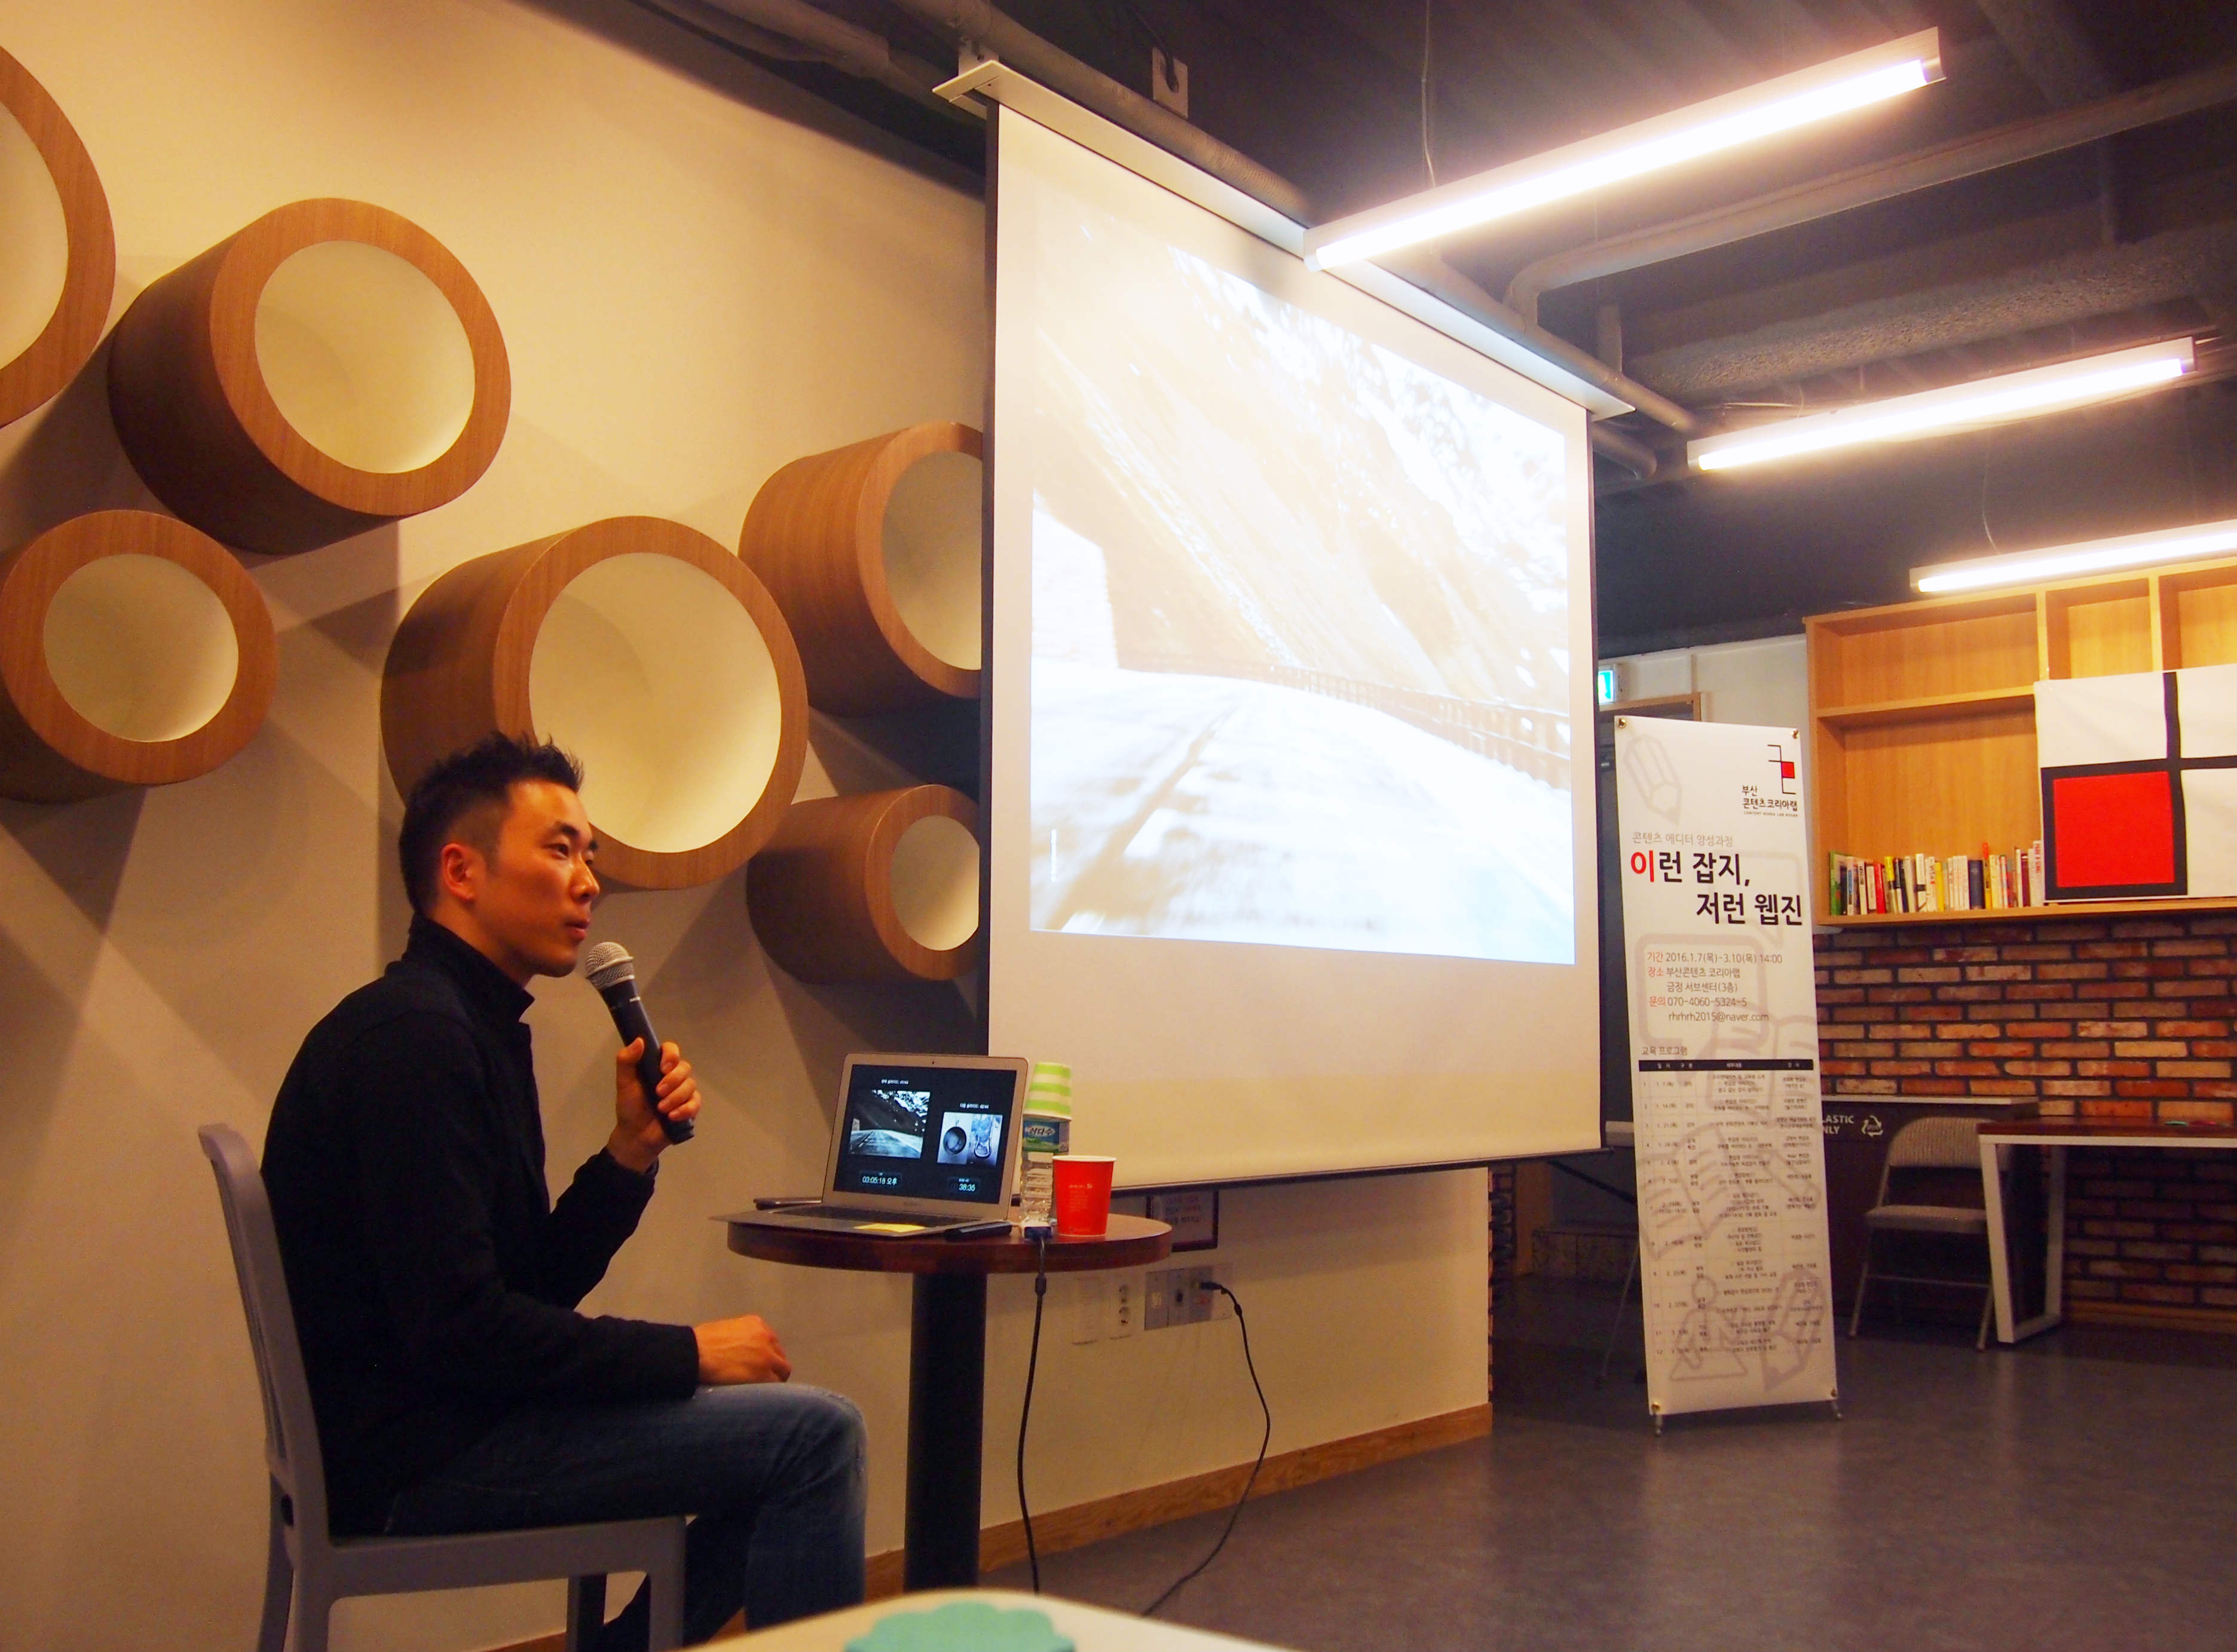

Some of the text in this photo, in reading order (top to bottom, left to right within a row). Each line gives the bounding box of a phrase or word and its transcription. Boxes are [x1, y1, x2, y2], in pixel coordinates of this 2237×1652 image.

[1742, 785, 1757, 796] 부산
[1632, 831, 1733, 847] 콘텐츠 에디터 양성과정
[1631, 850, 1750, 886] 이런 잡지,
[1696, 892, 1803, 926] 저런 웹진
[1647, 952, 1663, 962] 기간
[1760, 954, 1782, 963] 14:00
[1648, 966, 1740, 978] 장소 부산콘텐츠 코리아랩
[1667, 981, 1683, 993] 금정
[1650, 996, 1666, 1007] 문의
[1669, 1011, 1769, 1022] rhrhrh2015@naver.com
[1642, 1046, 1688, 1056] 교육 프로그램
[1823, 1125, 1840, 1134] NLY
